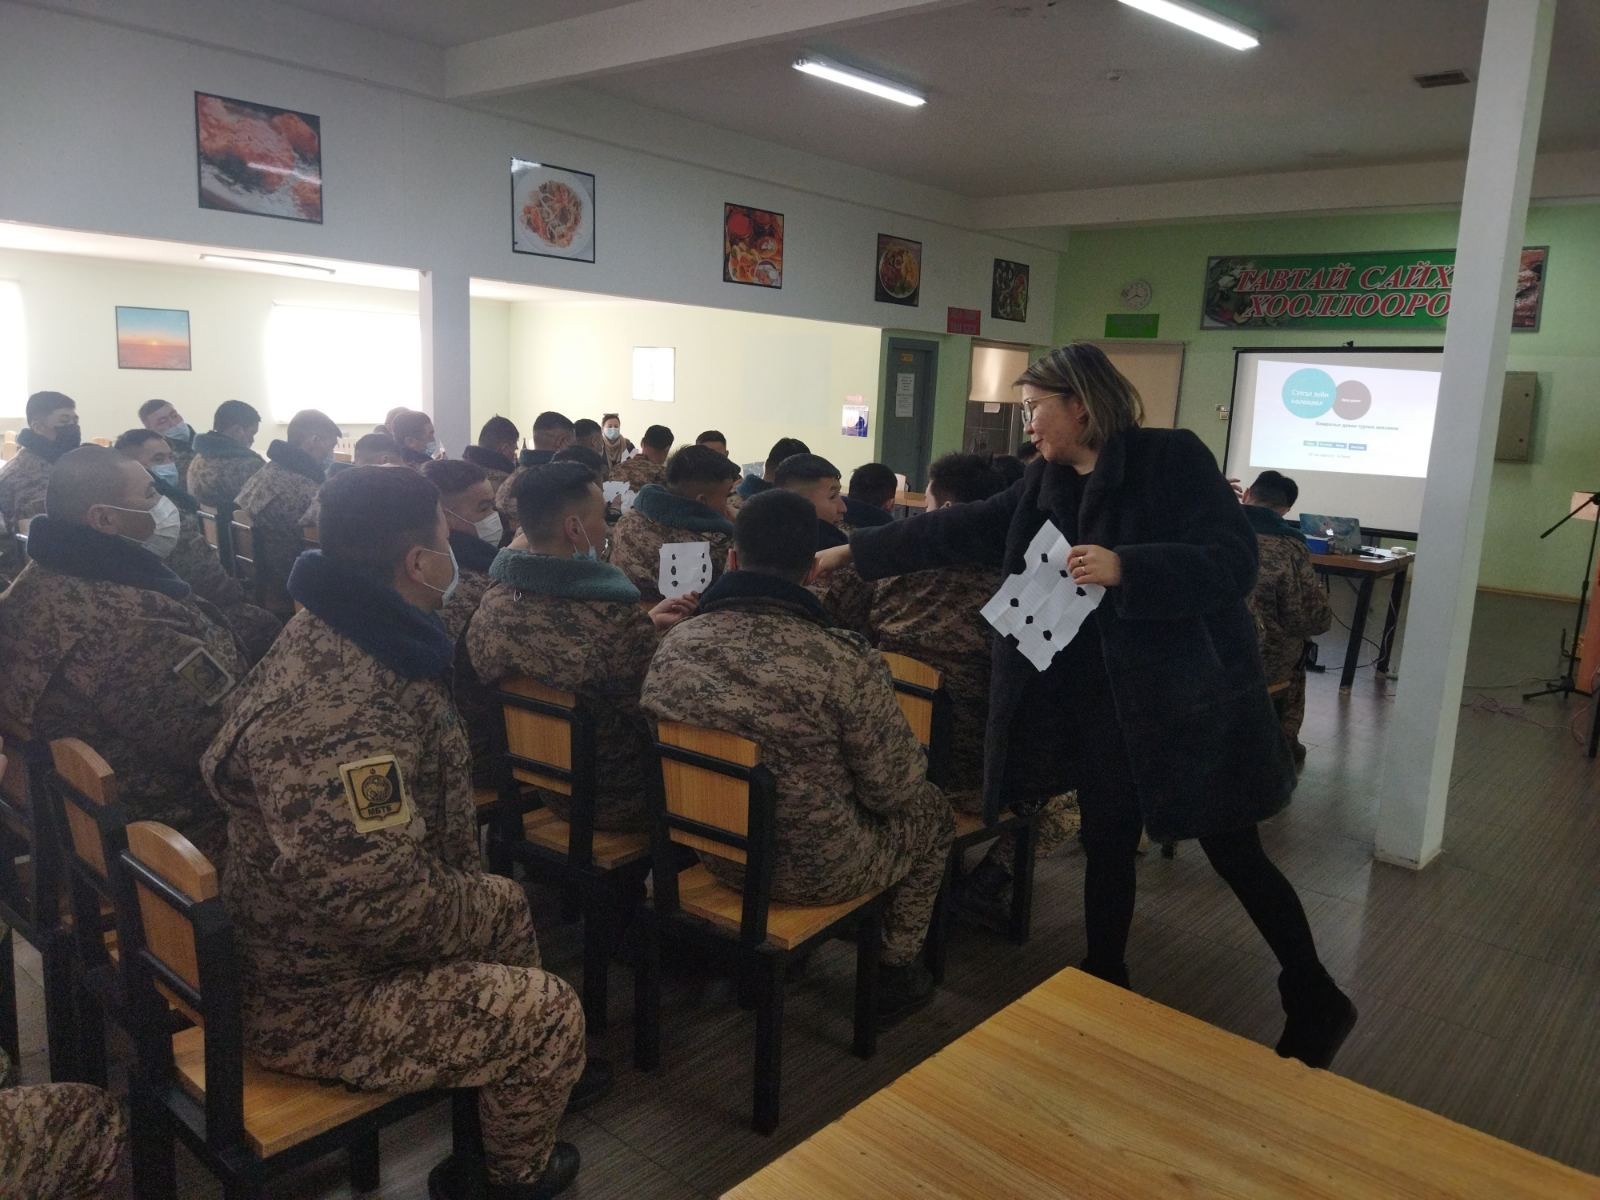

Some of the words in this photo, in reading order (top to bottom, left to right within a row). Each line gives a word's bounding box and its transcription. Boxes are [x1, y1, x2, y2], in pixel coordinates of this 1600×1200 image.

[1233, 263, 1355, 292] ТАВТАЙ
[1359, 261, 1456, 289] САЙХ
[1244, 292, 1451, 317] ХООЛЛООРО
